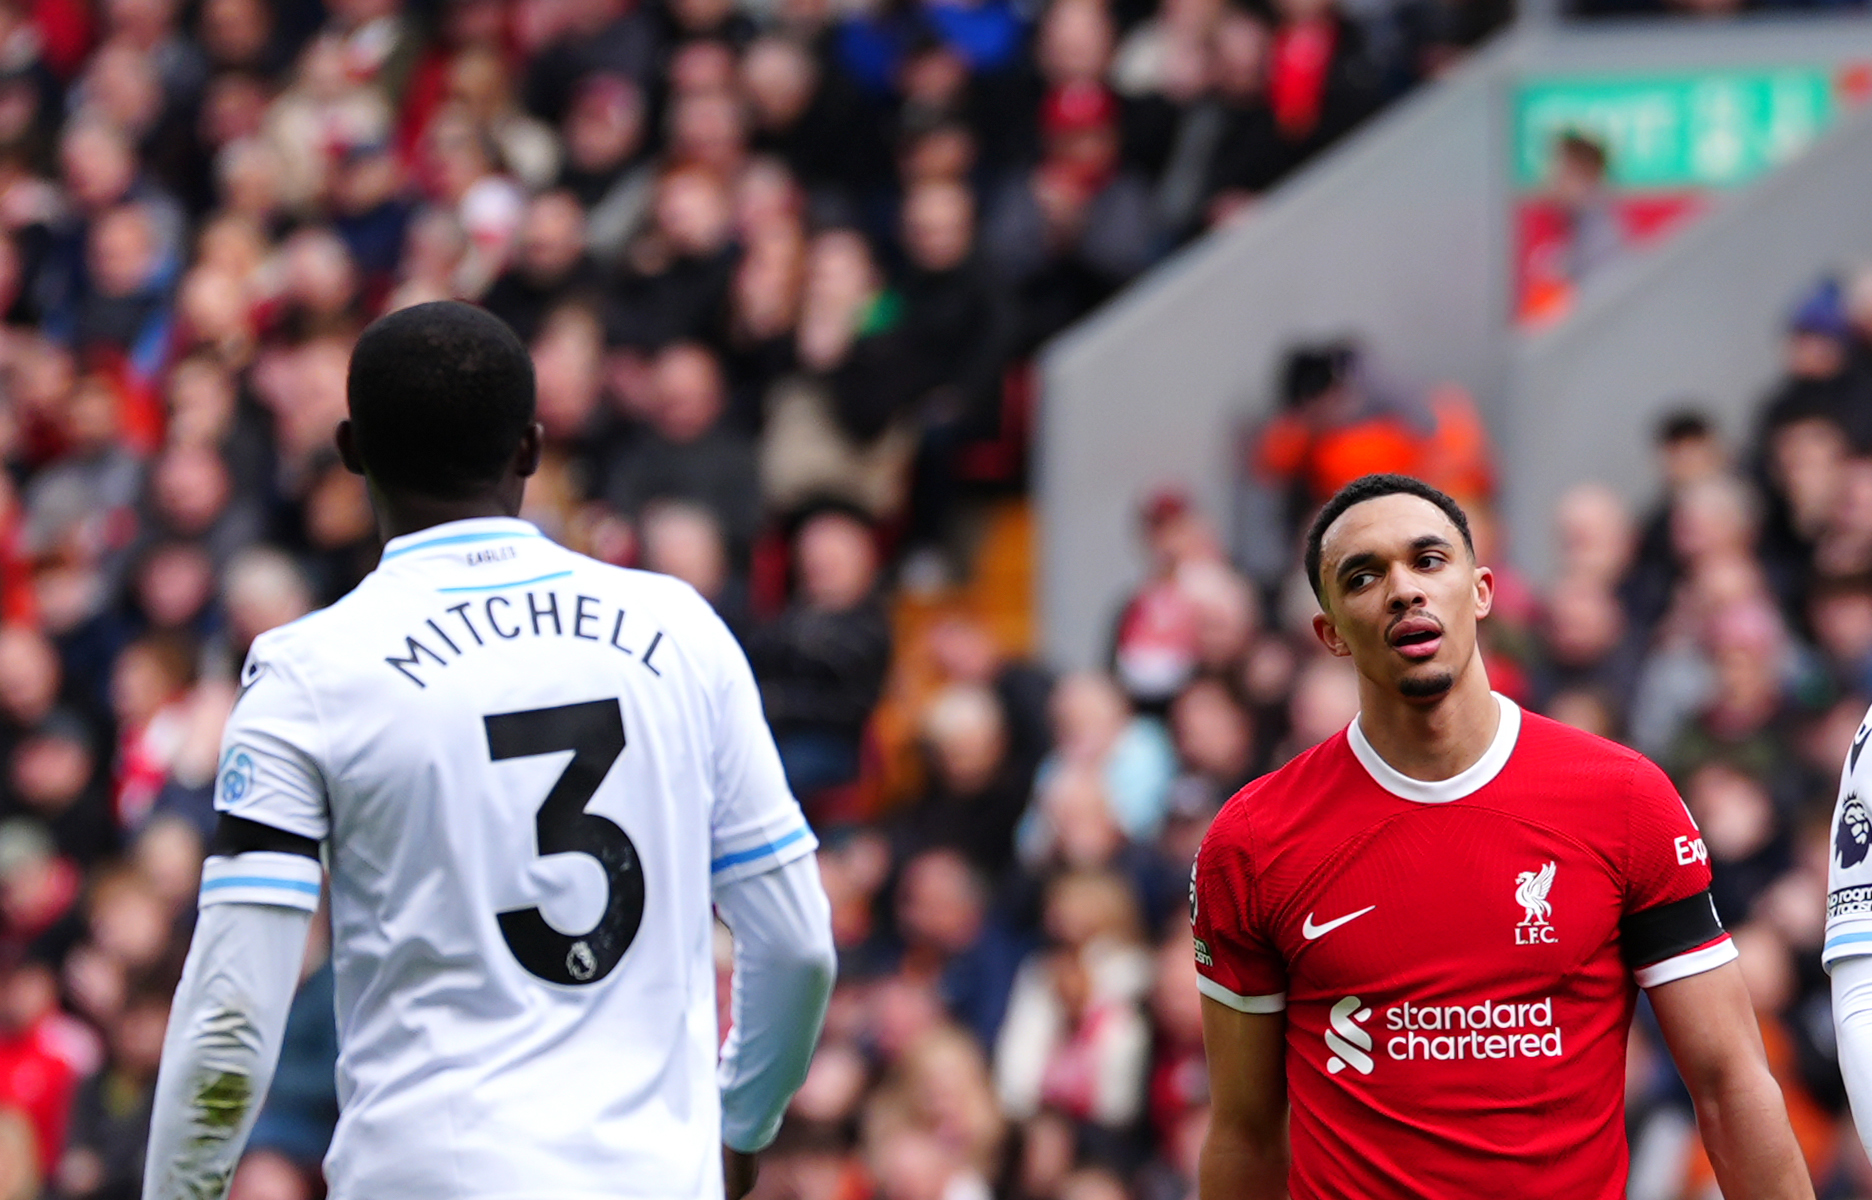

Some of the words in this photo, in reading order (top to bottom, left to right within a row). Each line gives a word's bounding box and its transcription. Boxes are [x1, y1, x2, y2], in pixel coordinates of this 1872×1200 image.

[384, 592, 665, 688] MITCHELL
[483, 697, 646, 986] 3
[1386, 996, 1552, 1031] standard
[1387, 1027, 1563, 1061] chartered
